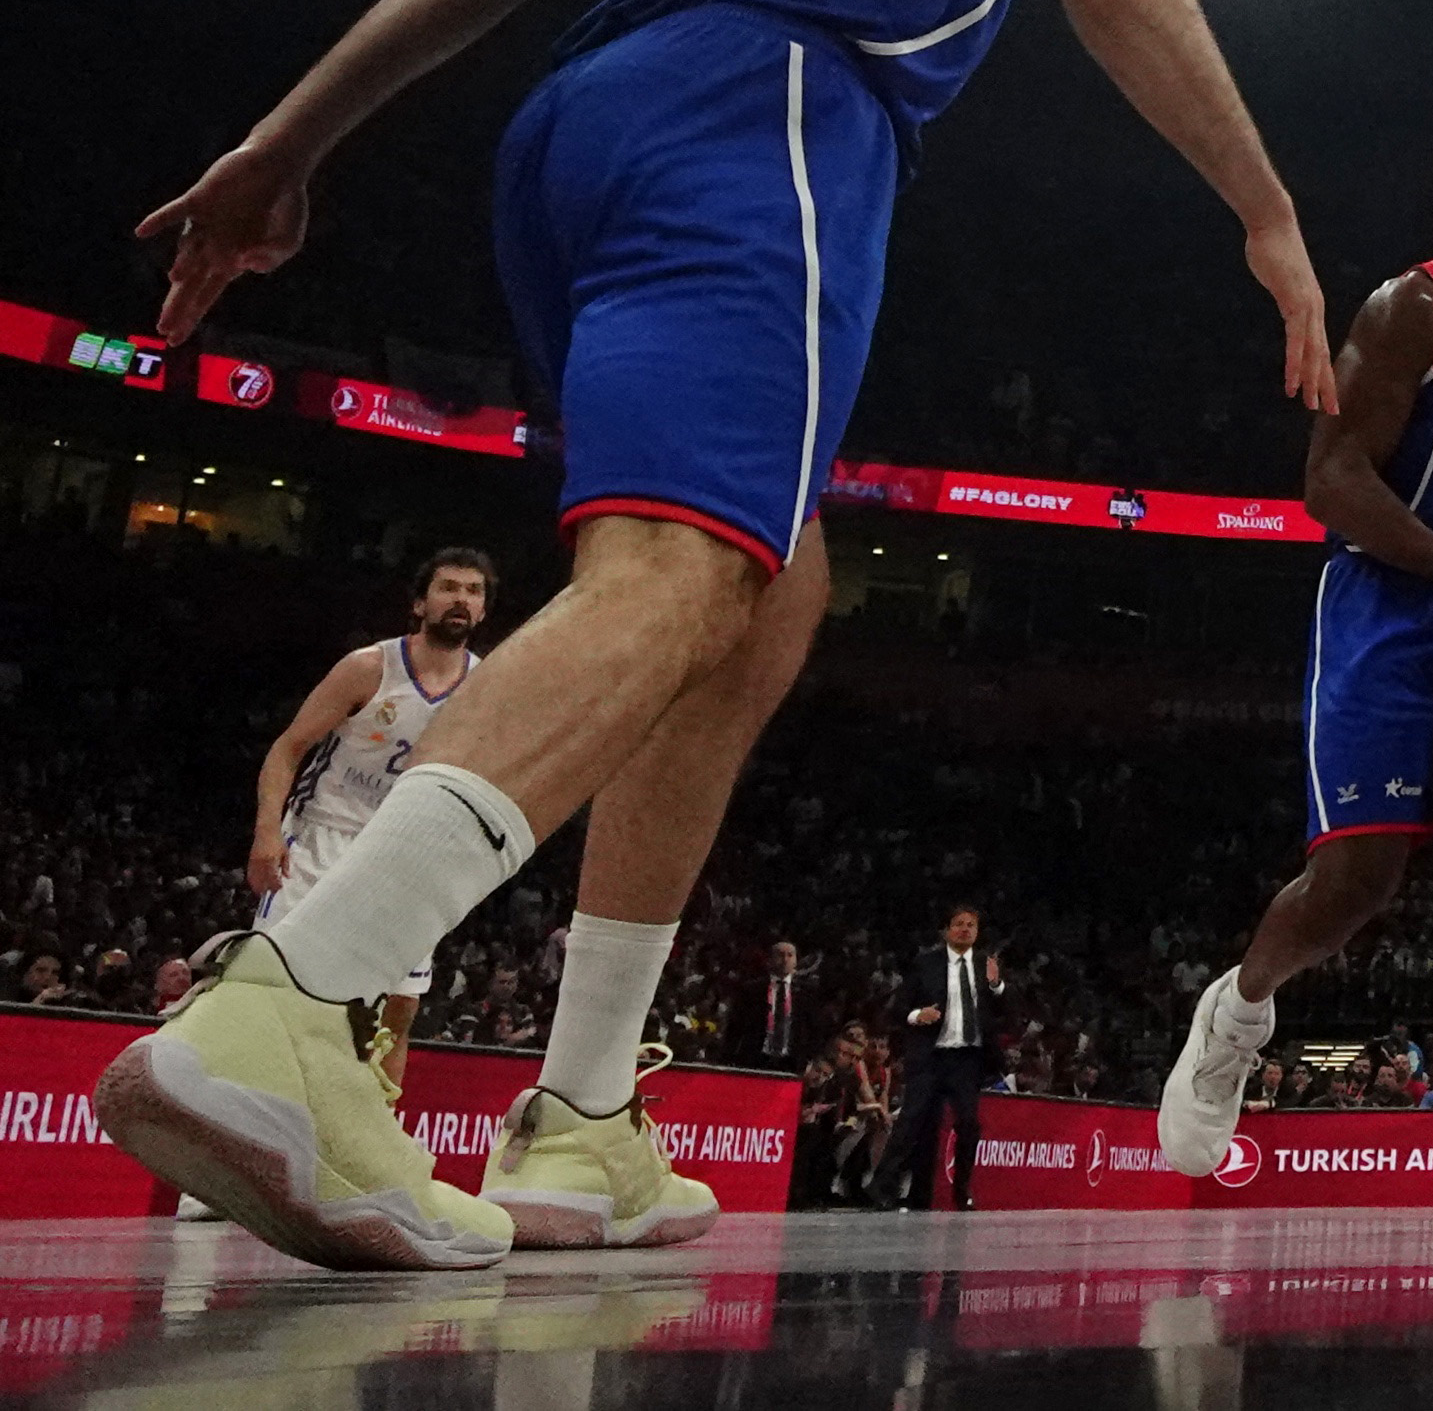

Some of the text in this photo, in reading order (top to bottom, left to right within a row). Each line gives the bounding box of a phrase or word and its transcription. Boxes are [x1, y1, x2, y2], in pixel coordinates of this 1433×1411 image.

[949, 487, 1073, 511] #F4GLORY
[1217, 512, 1284, 532] SPALDING
[386, 739, 412, 775] 2
[0, 1091, 114, 1144] IRLIN
[413, 1111, 501, 1155] AIRLIN
[699, 1125, 785, 1164] AIRLINES
[975, 1139, 1077, 1170] TURKISH AIRLINES
[1109, 1146, 1149, 1172] TURKISH
[1274, 1148, 1397, 1173] TURKISH
